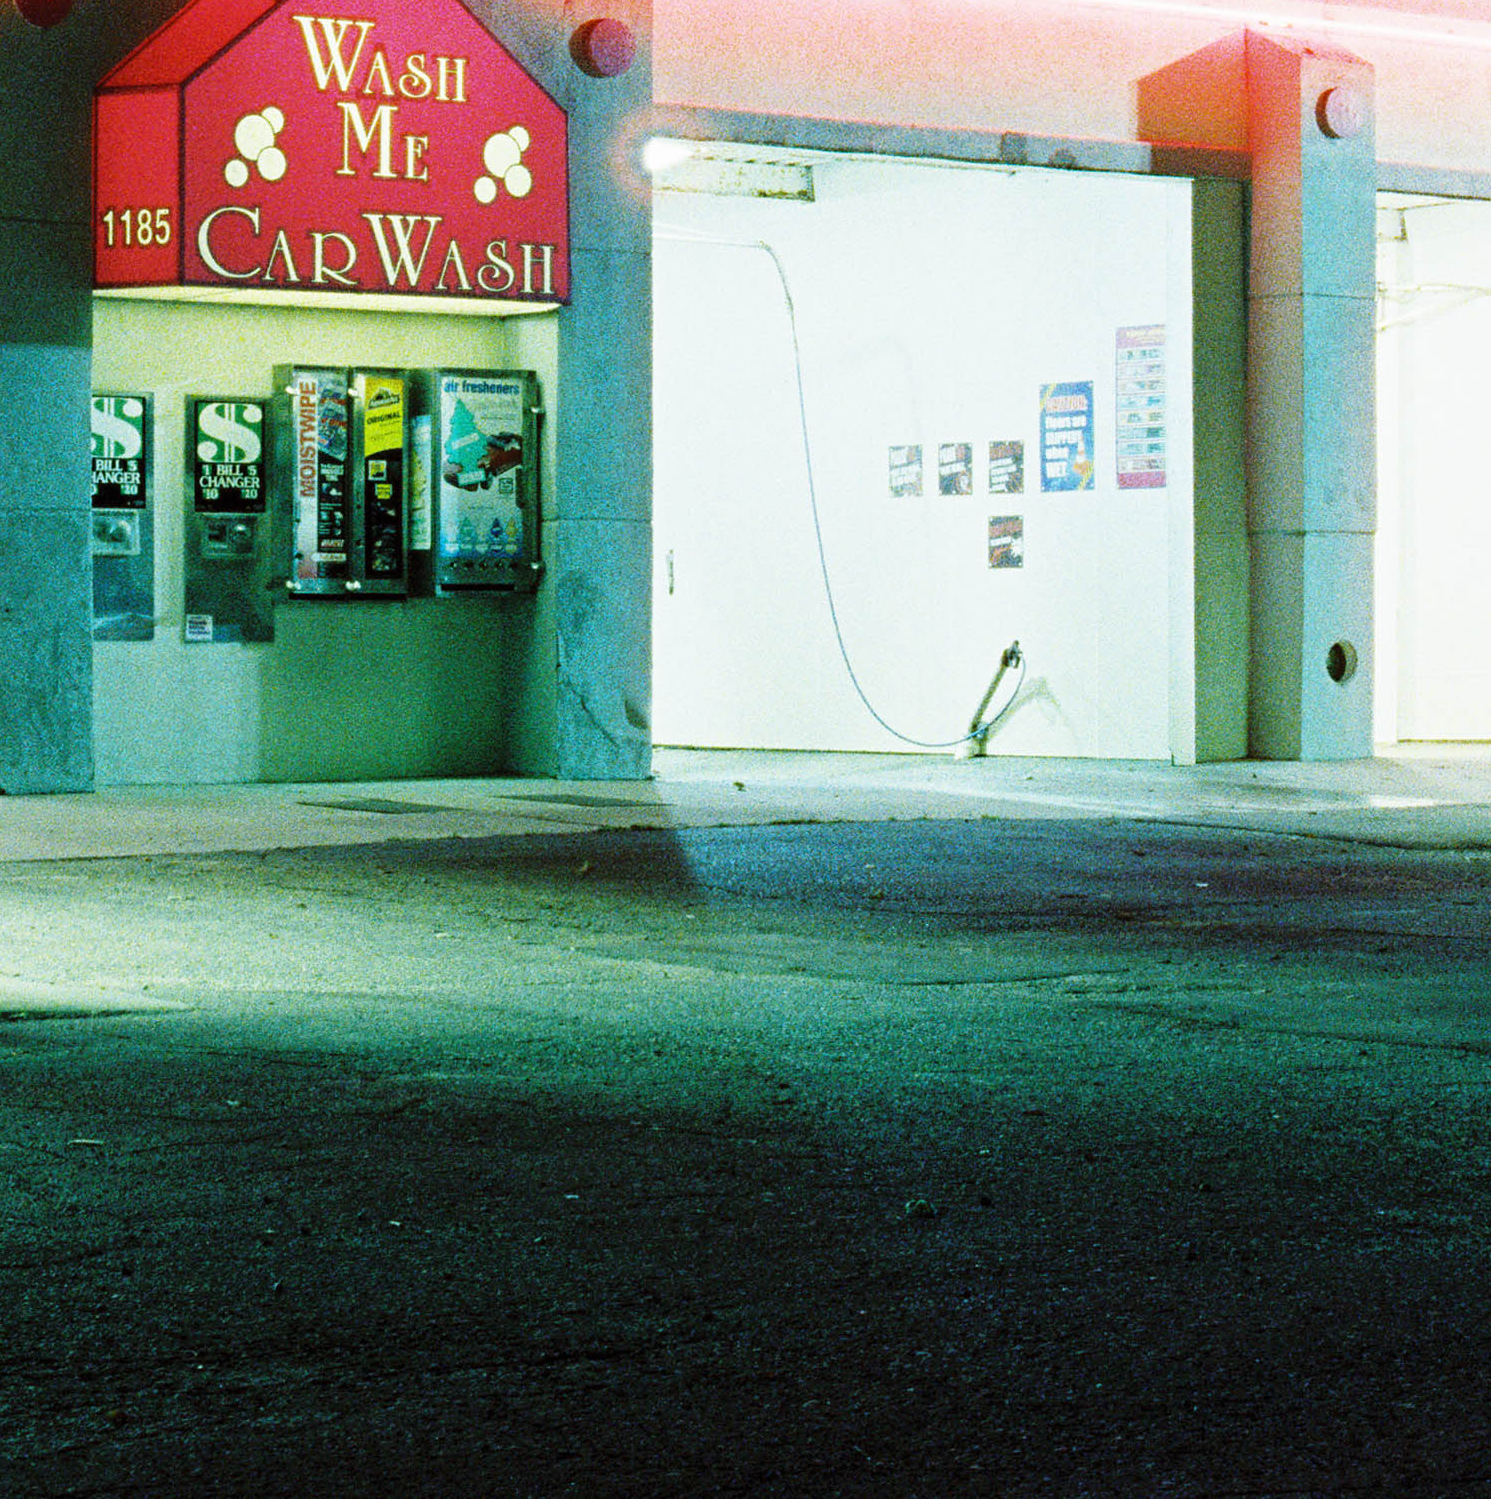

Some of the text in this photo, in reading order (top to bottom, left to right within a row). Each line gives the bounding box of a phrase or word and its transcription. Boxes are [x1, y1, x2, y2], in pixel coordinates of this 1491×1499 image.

[293, 15, 467, 103] WASH
[336, 101, 429, 183] ME
[102, 208, 171, 246] 1185
[300, 381, 316, 498] MOISTWIPE
[91, 472, 141, 485] HANGER
[96, 459, 123, 472] BILL
[216, 464, 244, 477] BILL
[199, 475, 261, 489] CHANGER
